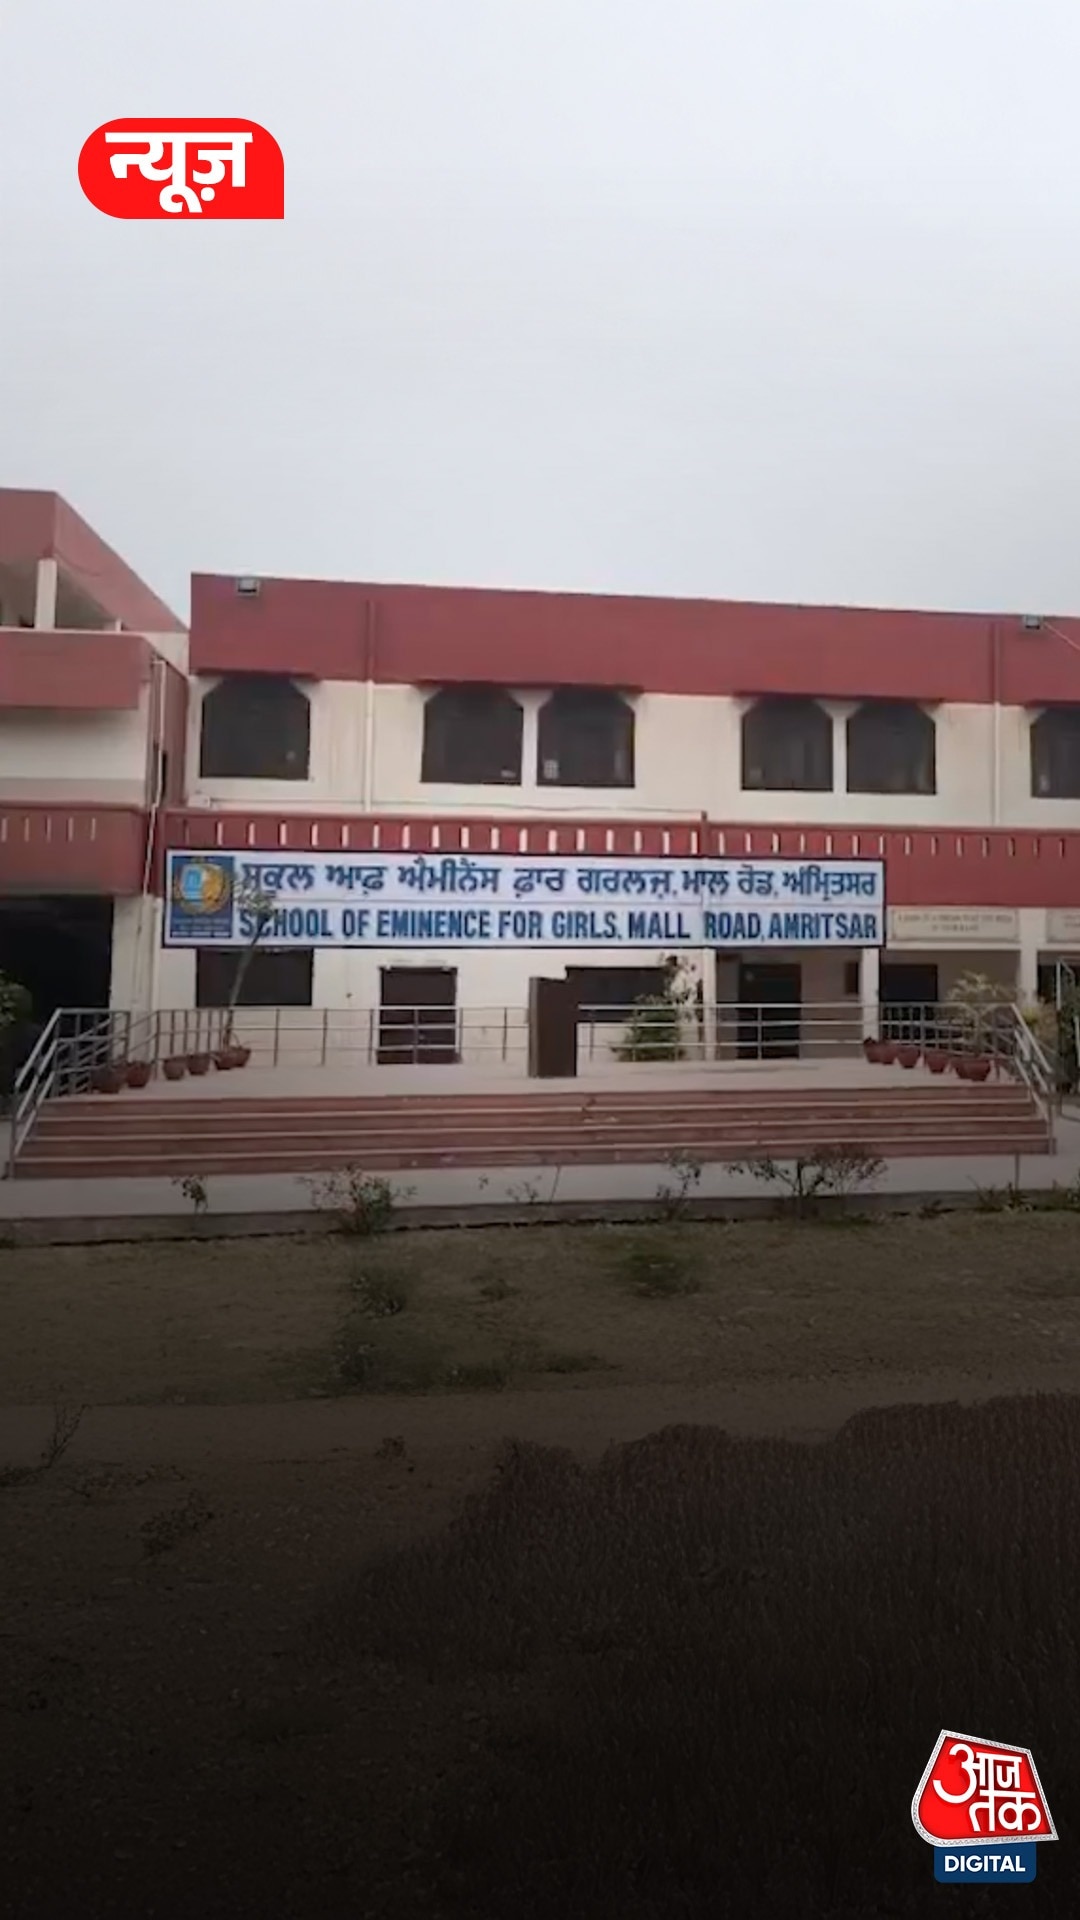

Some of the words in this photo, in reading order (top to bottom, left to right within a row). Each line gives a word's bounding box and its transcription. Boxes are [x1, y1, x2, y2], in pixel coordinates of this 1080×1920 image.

[325, 864, 388, 898] ਆਫ਼
[682, 869, 729, 896] ਮਾਲ
[342, 908, 370, 938] OF
[377, 910, 491, 939] EMINENCE
[499, 910, 543, 939] FOR
[551, 911, 622, 941] GIRLS,
[628, 911, 691, 939] MALL
[767, 912, 877, 940] AMRITSAR
